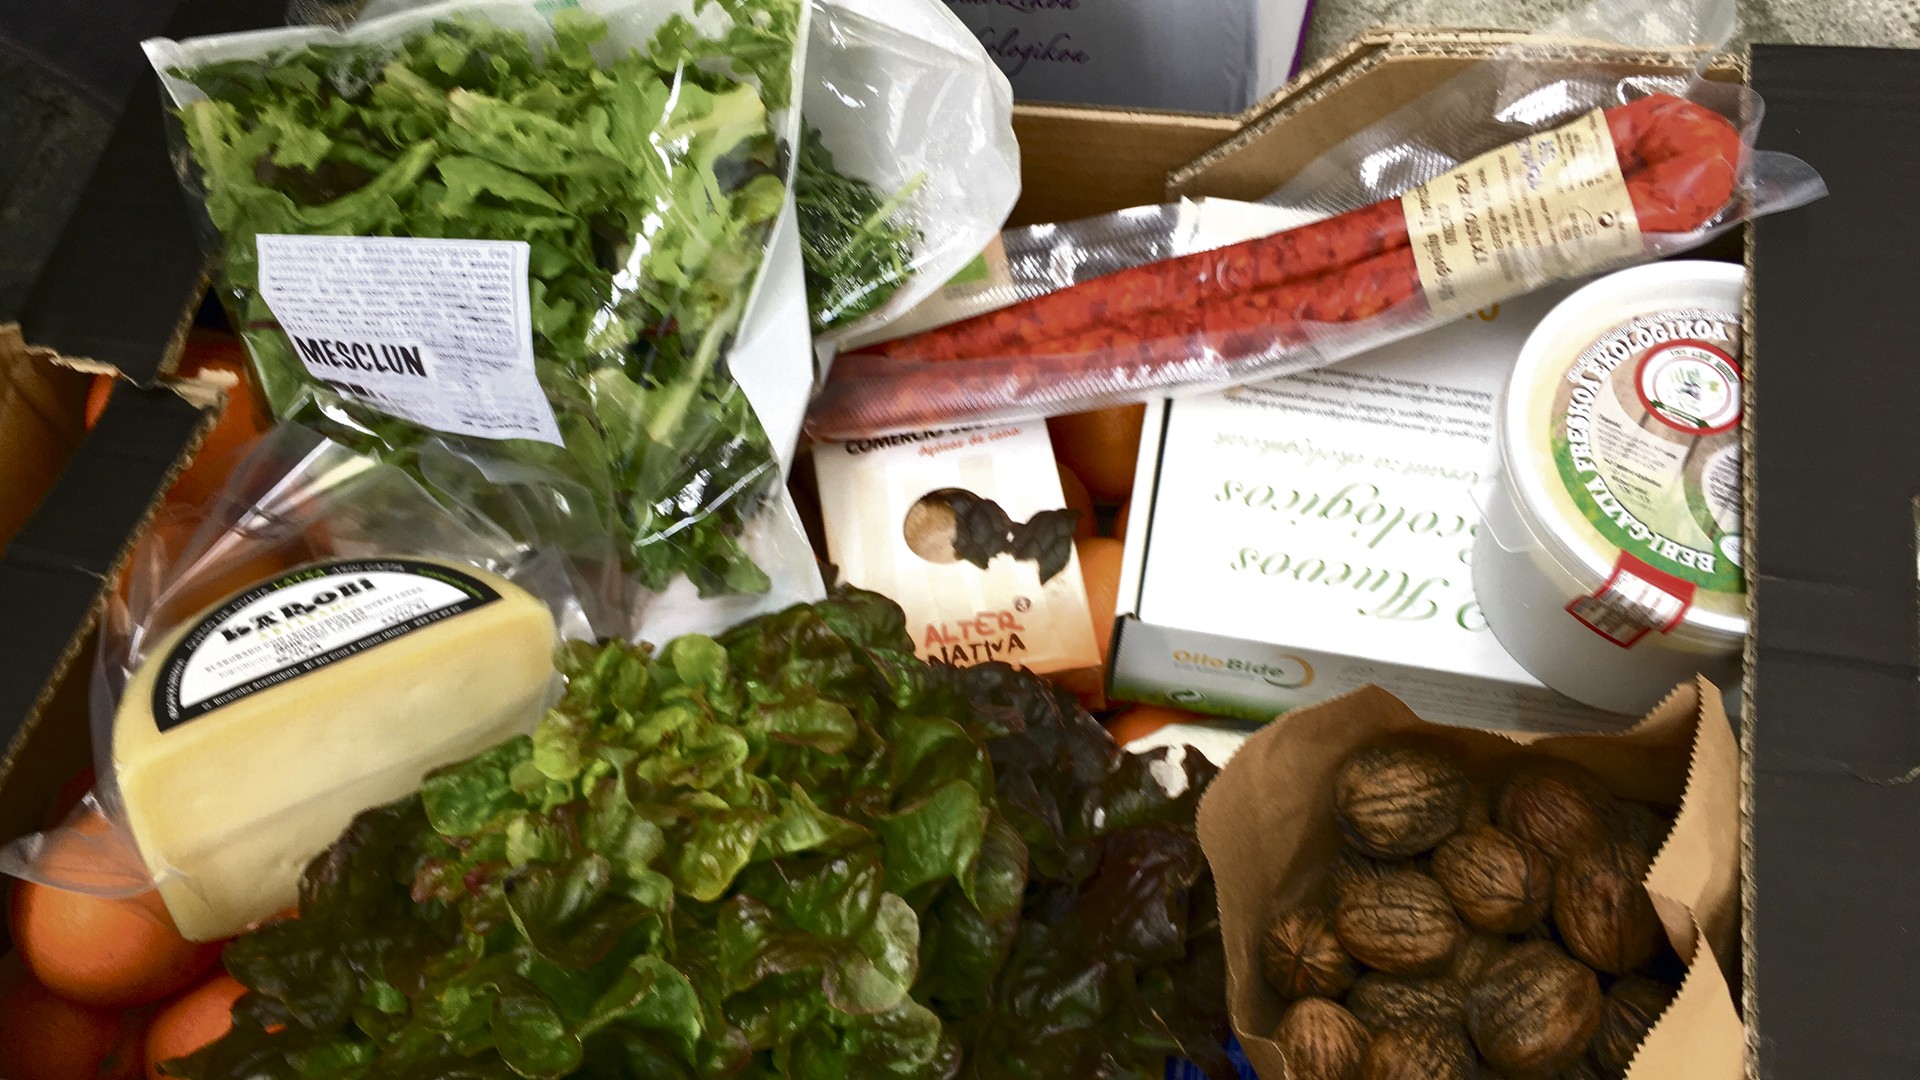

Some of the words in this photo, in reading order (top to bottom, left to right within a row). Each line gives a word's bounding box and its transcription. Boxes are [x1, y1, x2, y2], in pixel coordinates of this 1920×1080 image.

[293, 334, 428, 378] MESCLUN
[1565, 370, 1603, 475] FRESKOA
[1587, 318, 1730, 381] EKOLOGIKOA
[1230, 546, 1451, 622] Huevos
[924, 610, 1025, 649] ALTER
[927, 632, 1026, 668] NATIVA
